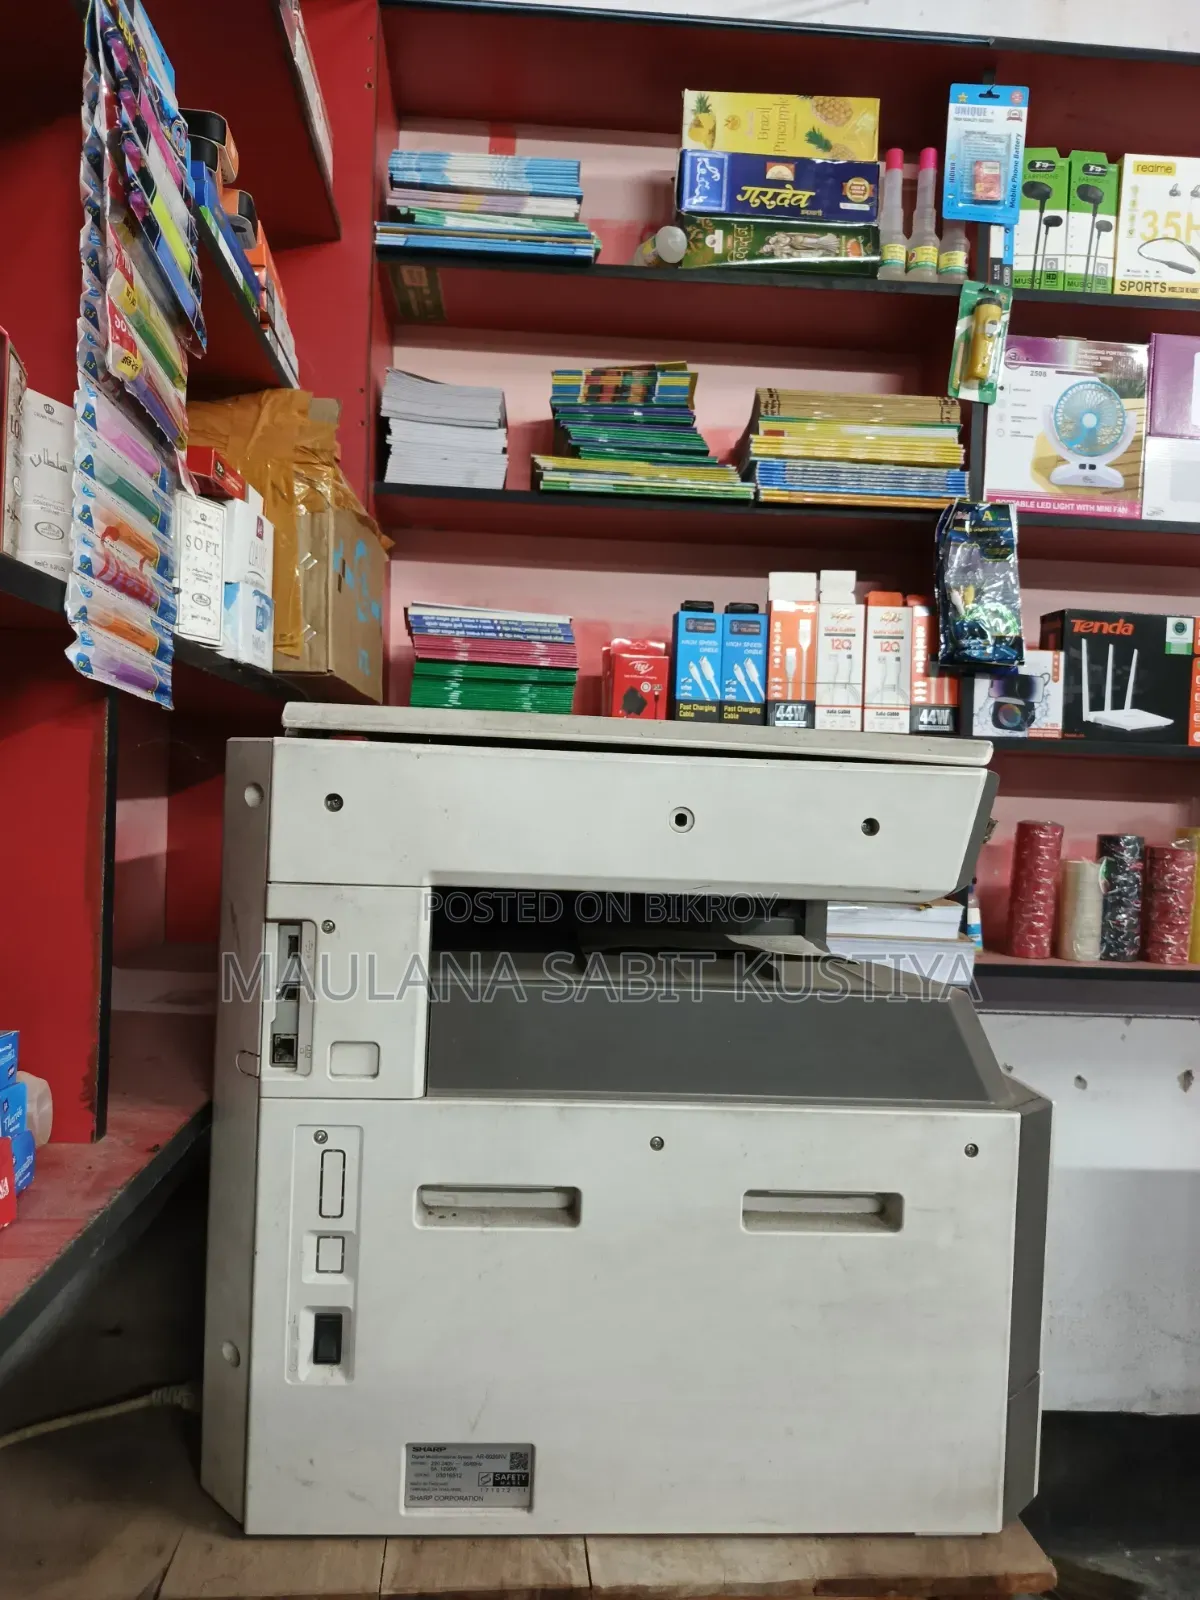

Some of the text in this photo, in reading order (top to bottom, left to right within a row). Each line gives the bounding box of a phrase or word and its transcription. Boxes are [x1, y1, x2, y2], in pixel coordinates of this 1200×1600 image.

[955, 106, 987, 116] UNIQUE
[756, 107, 772, 141] Brazil
[773, 96, 791, 154] Pineapple
[1008, 133, 1022, 208] Mobile Phone Battery
[1136, 163, 1173, 175] realme
[1014, 277, 1041, 286] MUSIC
[1067, 280, 1093, 289] MUSIC
[1119, 281, 1167, 294] SPORTS
[29, 448, 69, 474] سلطان
[1036, 501, 1052, 510] LED
[1052, 502, 1075, 511] LIGHT
[1076, 503, 1095, 512] WITH
[1096, 503, 1113, 513] MINI
[1113, 504, 1129, 514] FAN
[185, 534, 220, 556] SOFT
[1071, 619, 1135, 636] Tenda
[693, 704, 717, 713] Charging
[737, 706, 761, 715] Charging
[776, 705, 806, 721] 44W
[919, 709, 950, 723] 44W
[494, 1473, 526, 1481] SAFETY
